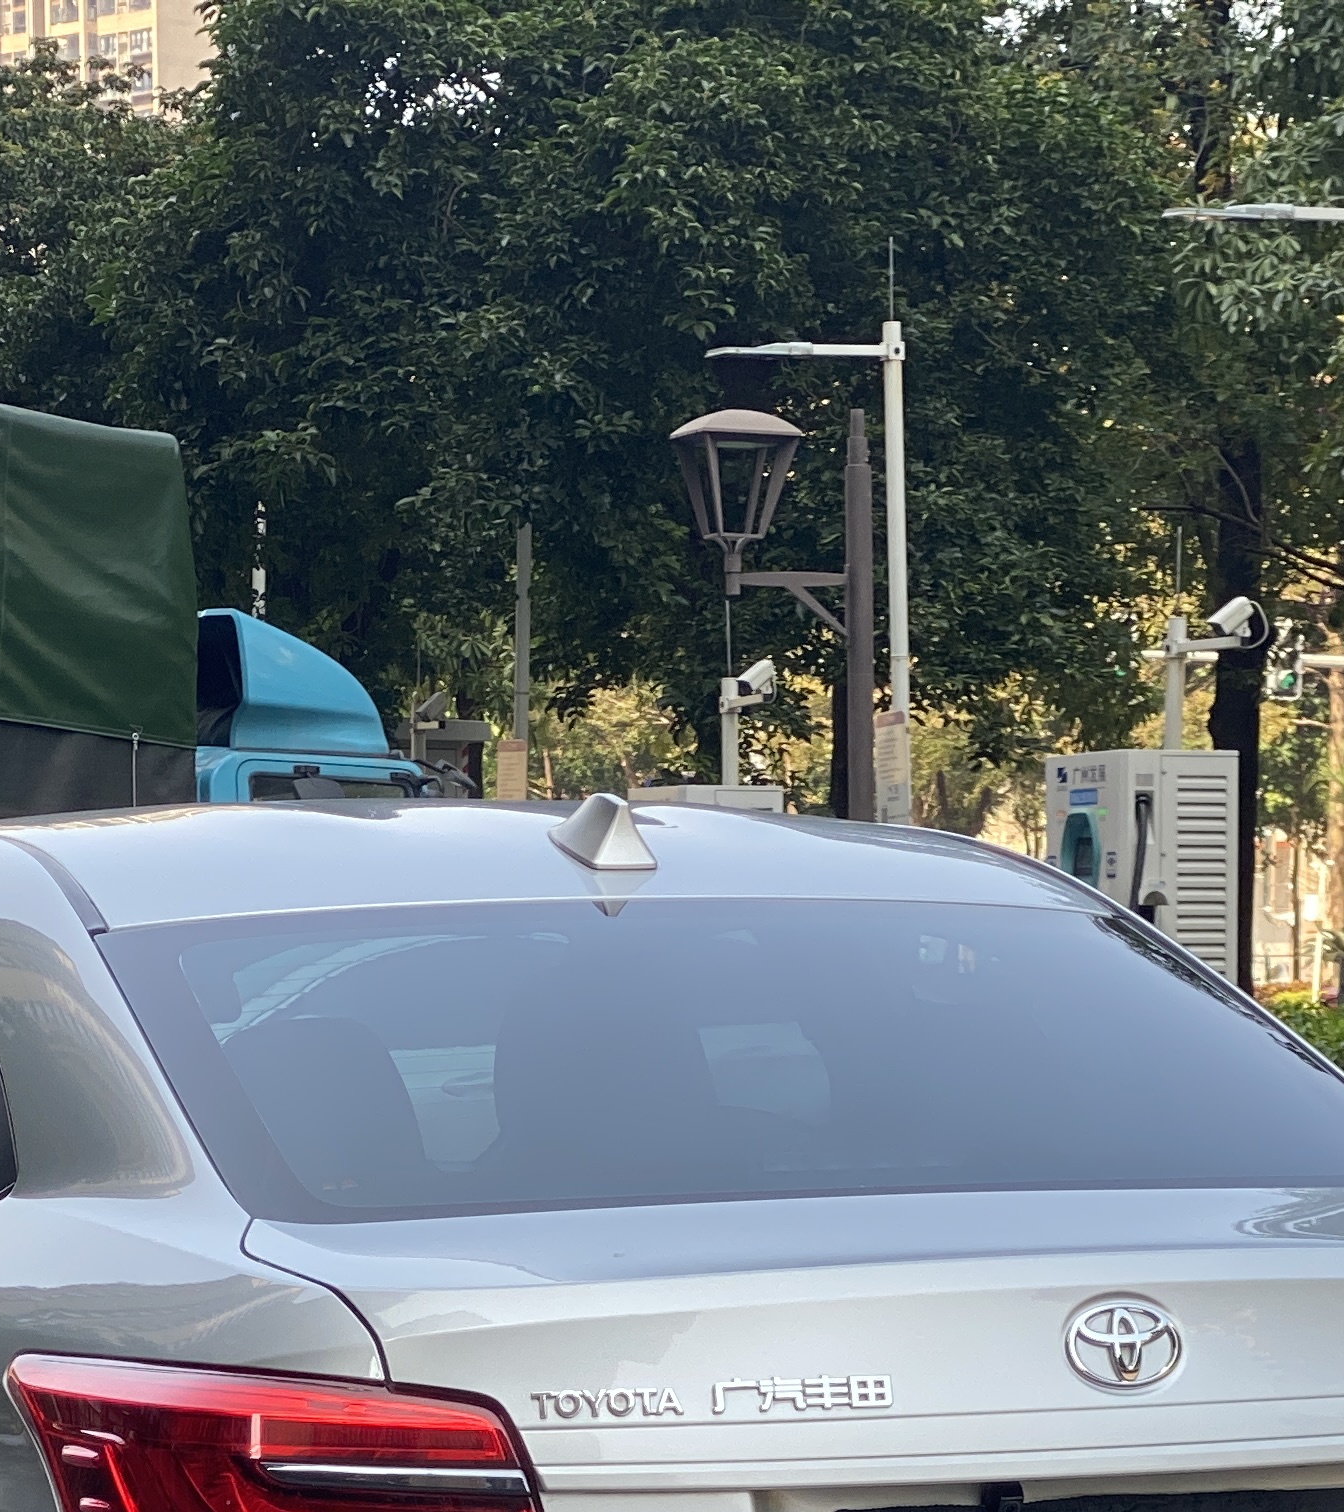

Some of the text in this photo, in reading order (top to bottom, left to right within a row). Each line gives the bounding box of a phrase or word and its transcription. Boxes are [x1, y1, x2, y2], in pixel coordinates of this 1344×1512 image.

[531, 1374, 894, 1419] TOYOTA 广汽丰田
